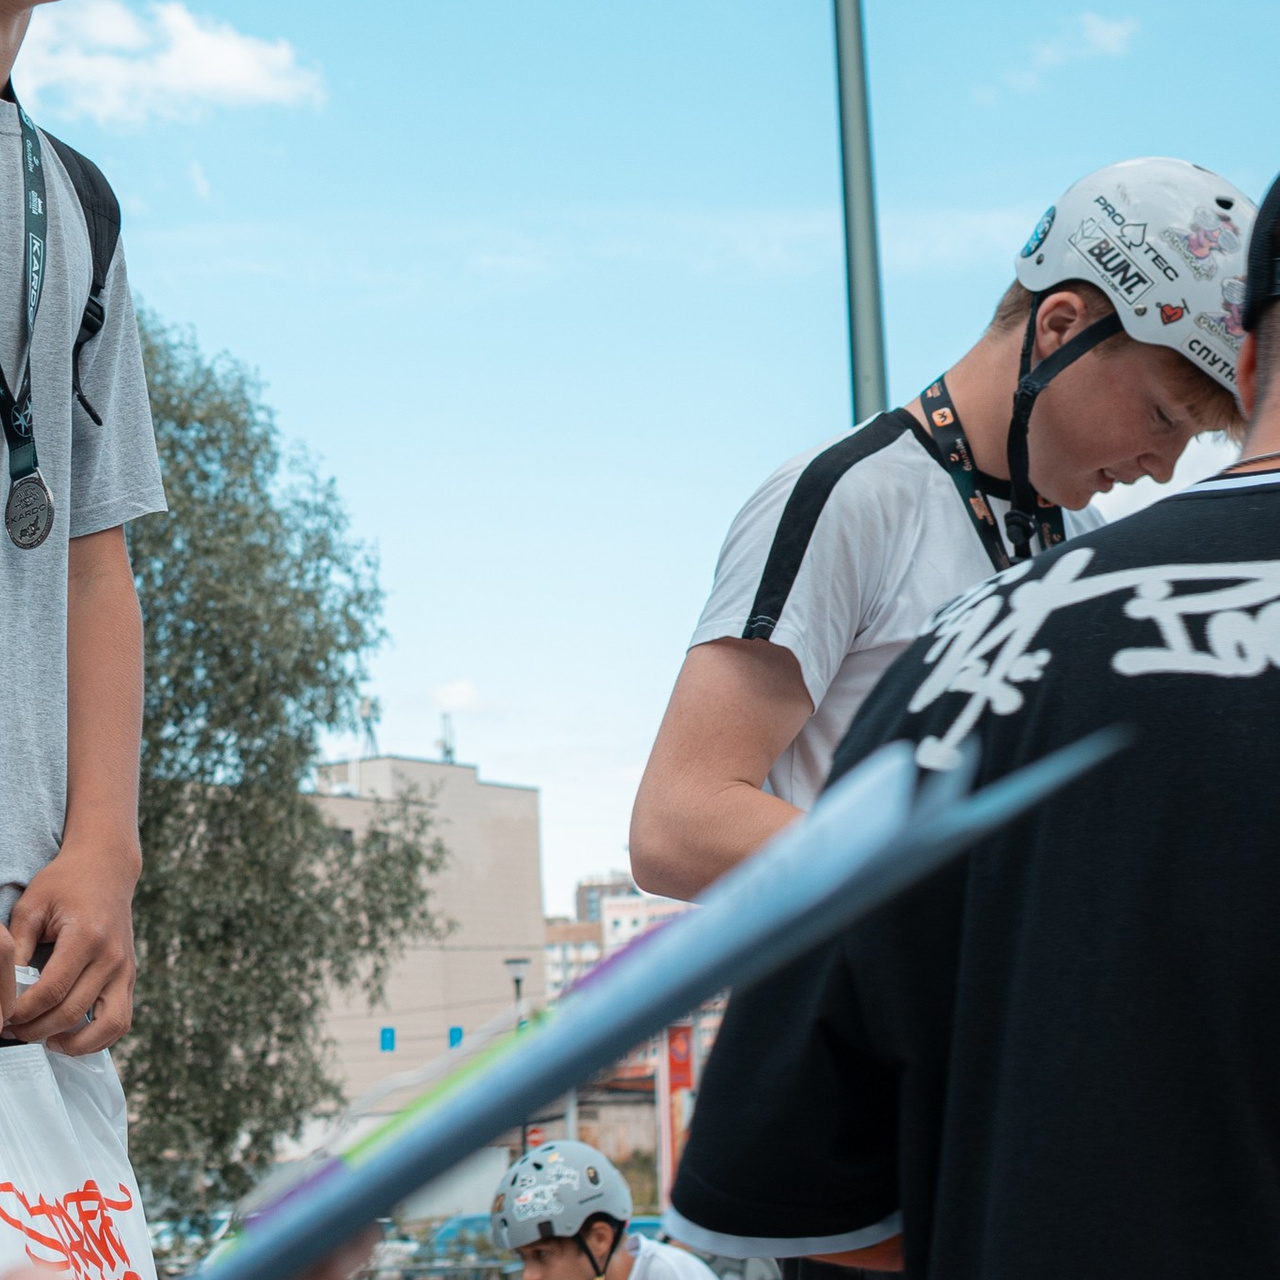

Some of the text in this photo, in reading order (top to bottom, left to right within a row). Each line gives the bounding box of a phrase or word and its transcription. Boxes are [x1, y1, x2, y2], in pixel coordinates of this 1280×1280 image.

[1094, 195, 1126, 226] PRO
[1144, 242, 1180, 282] TEC
[11, 503, 47, 524] KARDO
